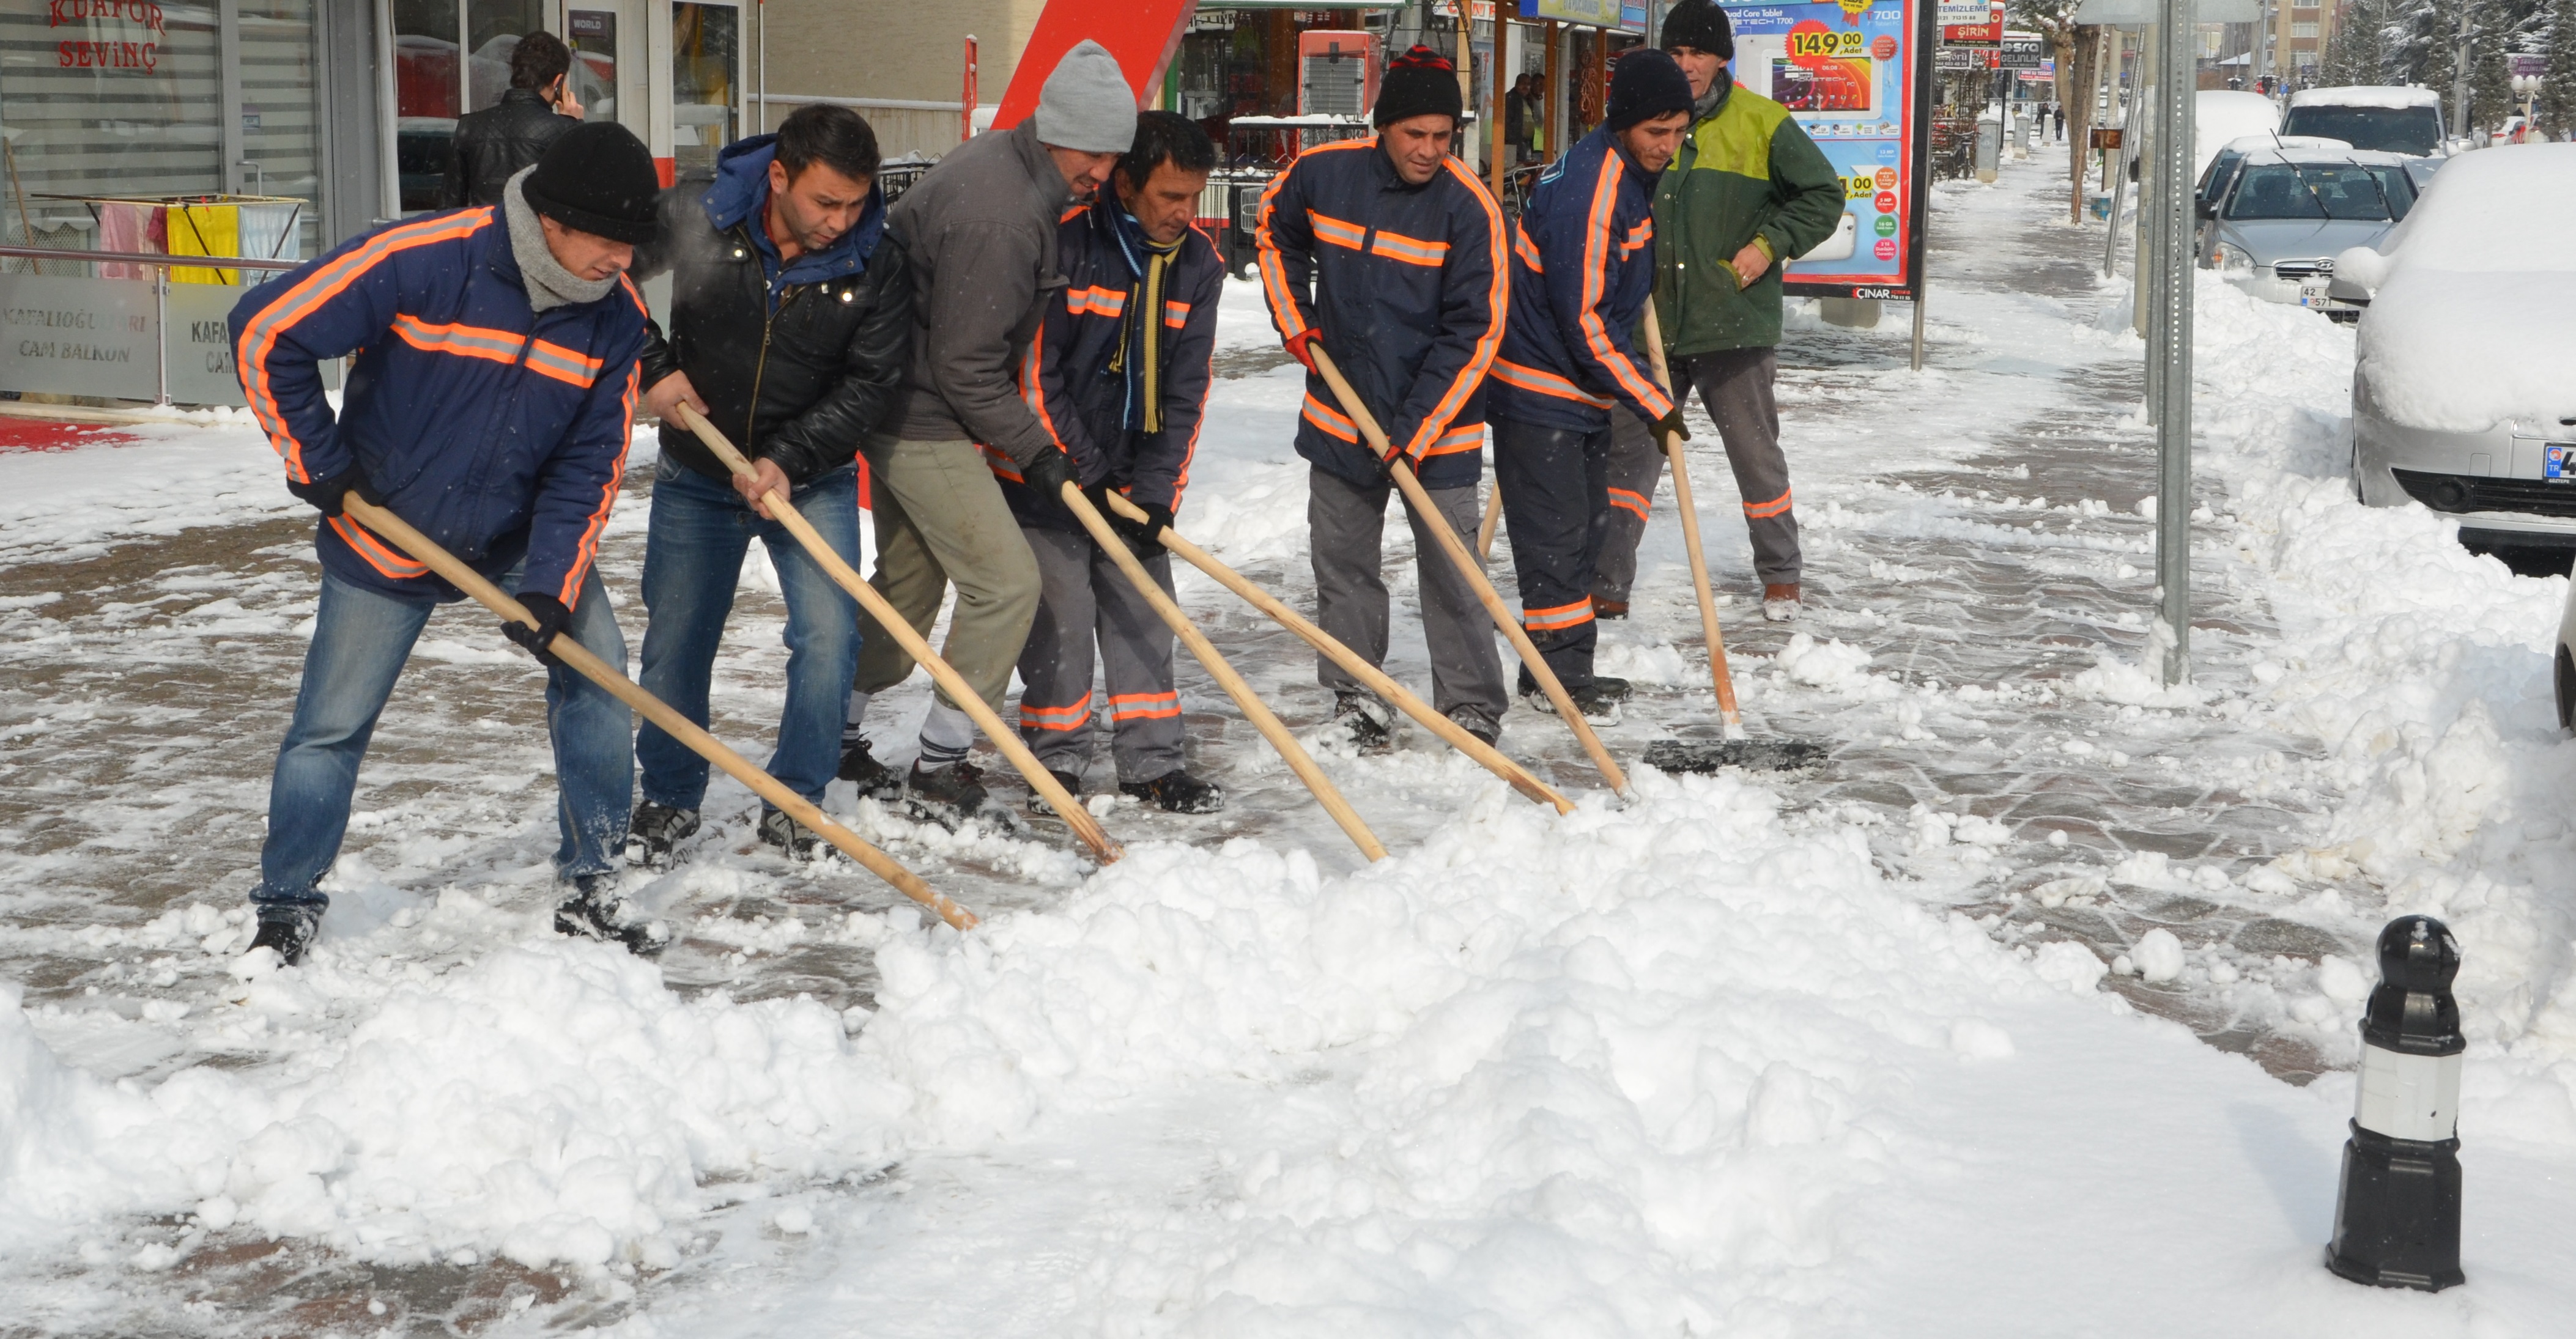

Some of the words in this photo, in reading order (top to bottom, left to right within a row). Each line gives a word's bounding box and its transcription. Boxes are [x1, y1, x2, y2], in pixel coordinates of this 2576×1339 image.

[1761, 9, 1783, 17] Tablet
[1865, 10, 1901, 20] T700
[573, 19, 602, 29] WORLD
[1958, 25, 1989, 39] ŞİRİN
[1794, 34, 1838, 55] 149
[1843, 34, 1862, 45] 00
[2004, 43, 2039, 53] esra
[1853, 178, 1871, 189] 00
[1857, 288, 1890, 300] ÇINAR
[19, 340, 54, 358] CAM
